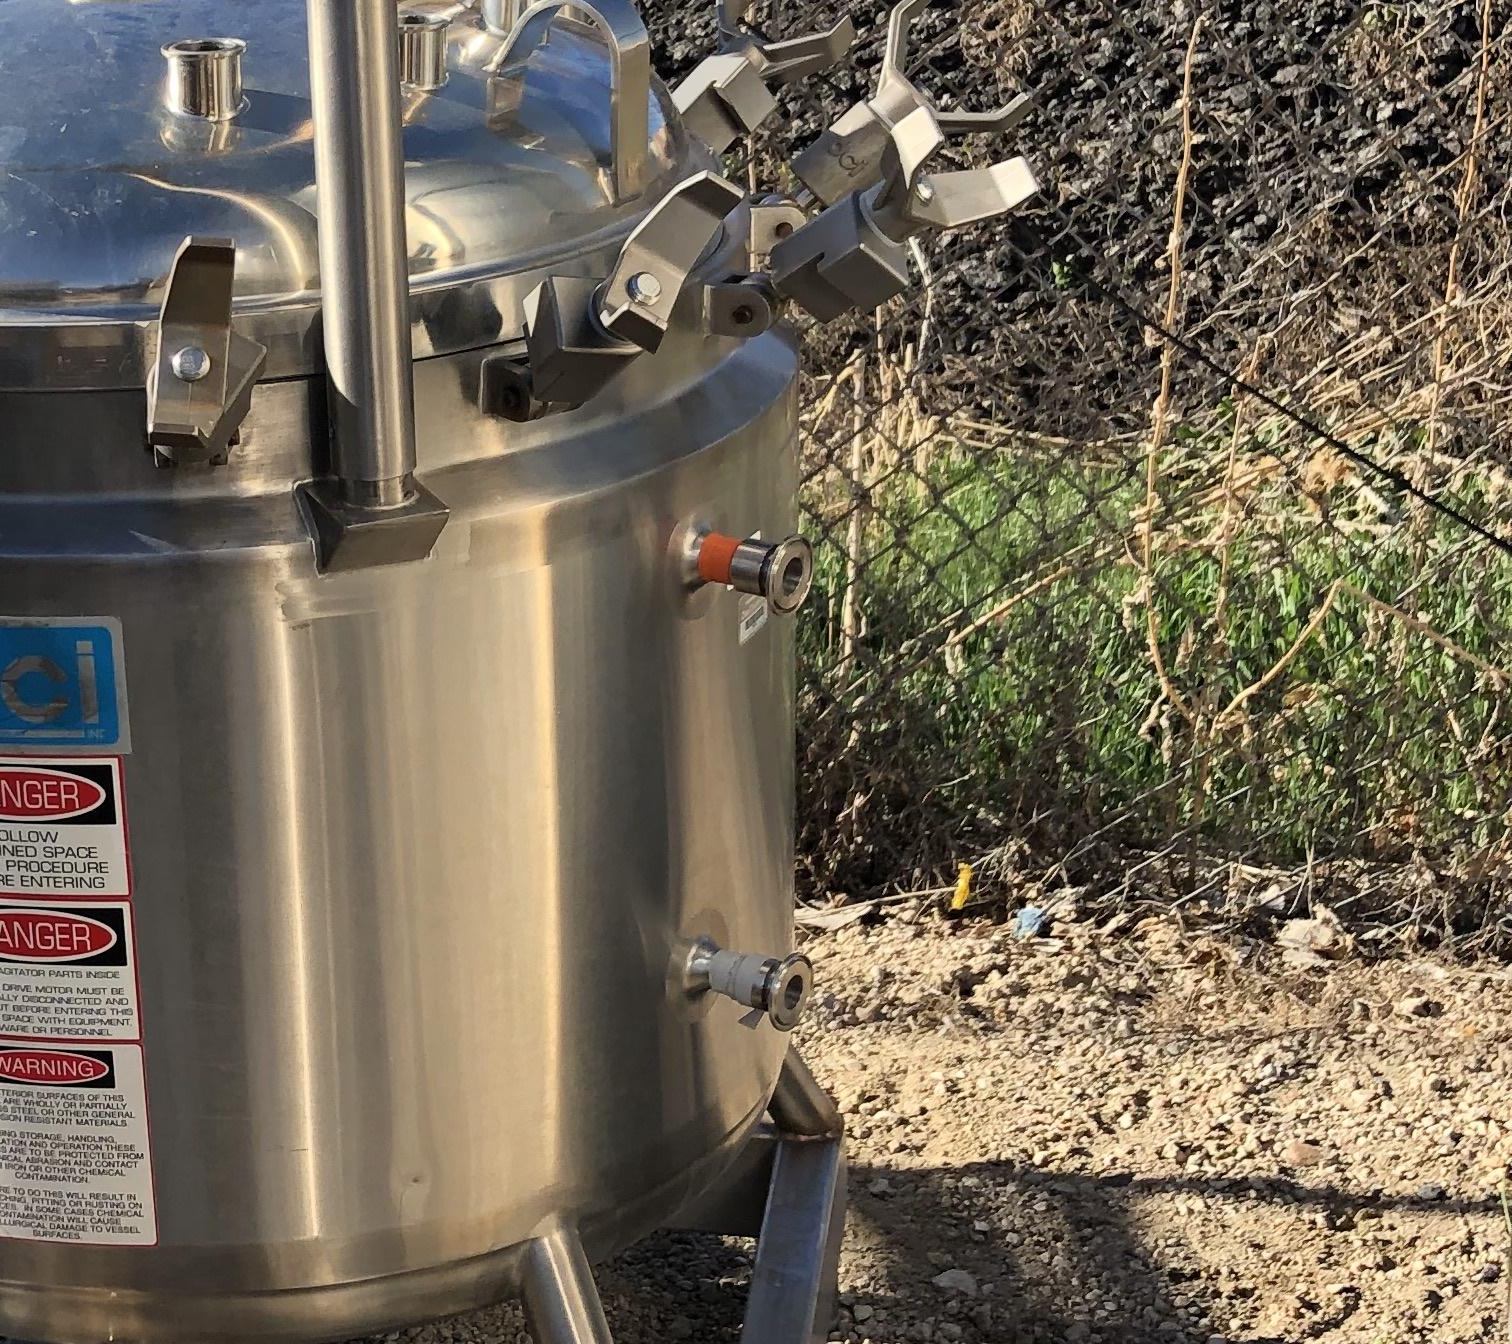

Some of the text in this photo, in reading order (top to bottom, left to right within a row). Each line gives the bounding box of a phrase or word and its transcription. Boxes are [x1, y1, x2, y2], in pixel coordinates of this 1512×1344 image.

[42, 847, 98, 858] SPACE
[5, 860, 109, 873] PROCEDURE
[20, 876, 105, 889] ENTERING
[48, 970, 82, 978] PARTS
[2, 983, 32, 992] DRIVE
[35, 985, 73, 994] MOTOR
[76, 987, 108, 995] MUST
[22, 995, 102, 1005] DISCONNECTED
[12, 1005, 51, 1014] BEFORE
[54, 1007, 107, 1015] ENTERING
[2, 1013, 35, 1023] SPACE
[37, 1016, 66, 1024] WITH
[32, 1026, 47, 1034] OR
[37, 1091, 85, 1101] SURFACES
[3, 1097, 21, 1105] ARE
[23, 1099, 60, 1108] WHOLLY
[63, 1101, 77, 1109] OR
[79, 1102, 127, 1110] PARTIALLY
[11, 1106, 39, 1115] STEEL
[40, 1108, 54, 1116] OR
[57, 1109, 89, 1118] OTHER
[91, 1111, 135, 1119] GENERAL
[24, 1116, 73, 1125] RESISTANT
[29, 1140, 48, 1148] AND
[50, 1142, 103, 1151] OPERATION
[8, 1147, 27, 1155] ARE
[29, 1148, 42, 1156] TO
[44, 1149, 57, 1157] BE
[59, 1150, 115, 1159] PROTECTED
[5, 1163, 27, 1171] IRON
[45, 1166, 76, 1175] OTHER
[78, 1168, 126, 1176] CHEMICAL
[13, 1187, 25, 1195] TO
[27, 1189, 41, 1197] DO
[42, 1190, 63, 1198] THIS
[89, 1193, 125, 1201] RESULT
[31, 1197, 66, 1206] PITTING
[85, 1201, 125, 1209] RUSTING
[36, 1206, 62, 1214] SOME
[63, 1208, 94, 1216] CASES
[97, 1209, 144, 1217] CHEMICAL
[67, 1216, 88, 1224] WILL
[90, 1217, 121, 1225] CAUSE
[49, 1223, 88, 1231] DAMAGE
[105, 1226, 141, 1234] VESSEL
